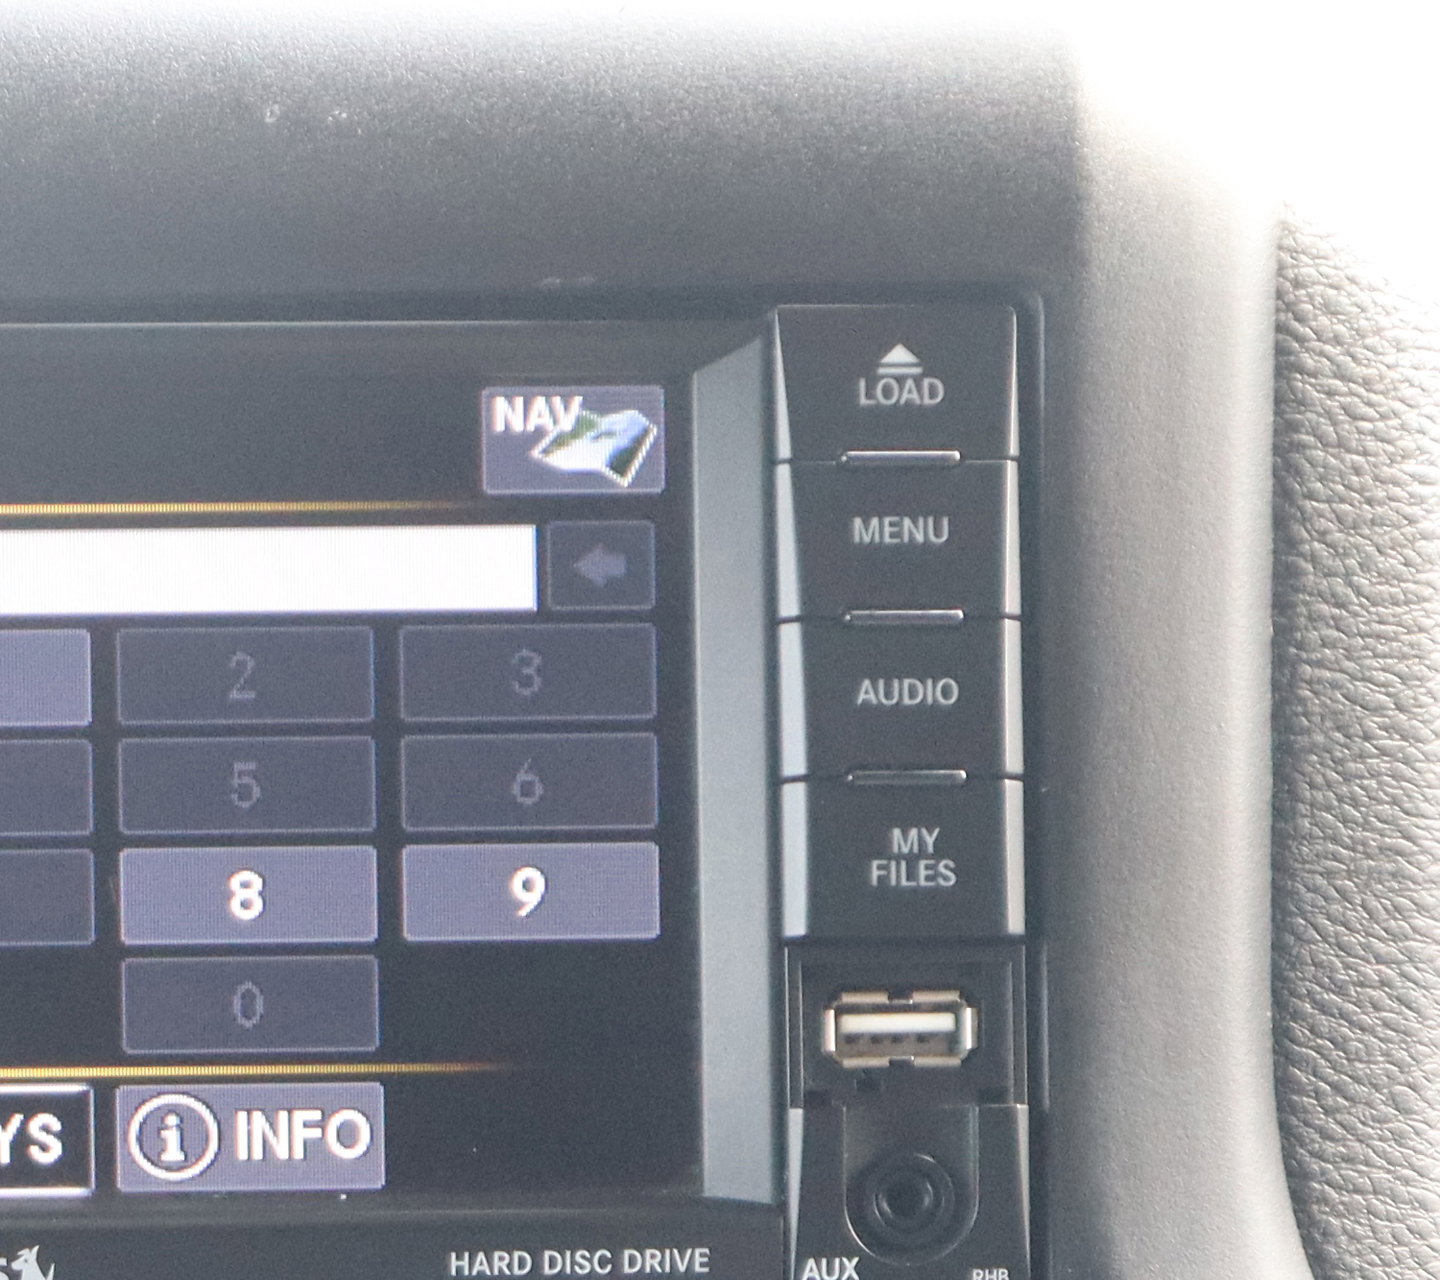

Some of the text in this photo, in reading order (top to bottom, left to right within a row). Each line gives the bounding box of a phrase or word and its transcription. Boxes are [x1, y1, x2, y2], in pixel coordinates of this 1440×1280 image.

[493, 395, 584, 434] NAV
[859, 377, 946, 406] LOAD
[852, 515, 951, 545] MENU
[227, 651, 258, 702] 2
[511, 648, 543, 697] 3
[856, 677, 960, 707] AUDIO
[230, 760, 261, 809] 5
[512, 757, 544, 806] 6
[891, 827, 941, 854] MY
[227, 868, 266, 923] 8
[510, 865, 547, 918] 9
[870, 859, 958, 888] FILES
[231, 980, 264, 1029] 0
[234, 1108, 373, 1162] INFO
[449, 1246, 712, 1277] HARD DISC DRIVE
